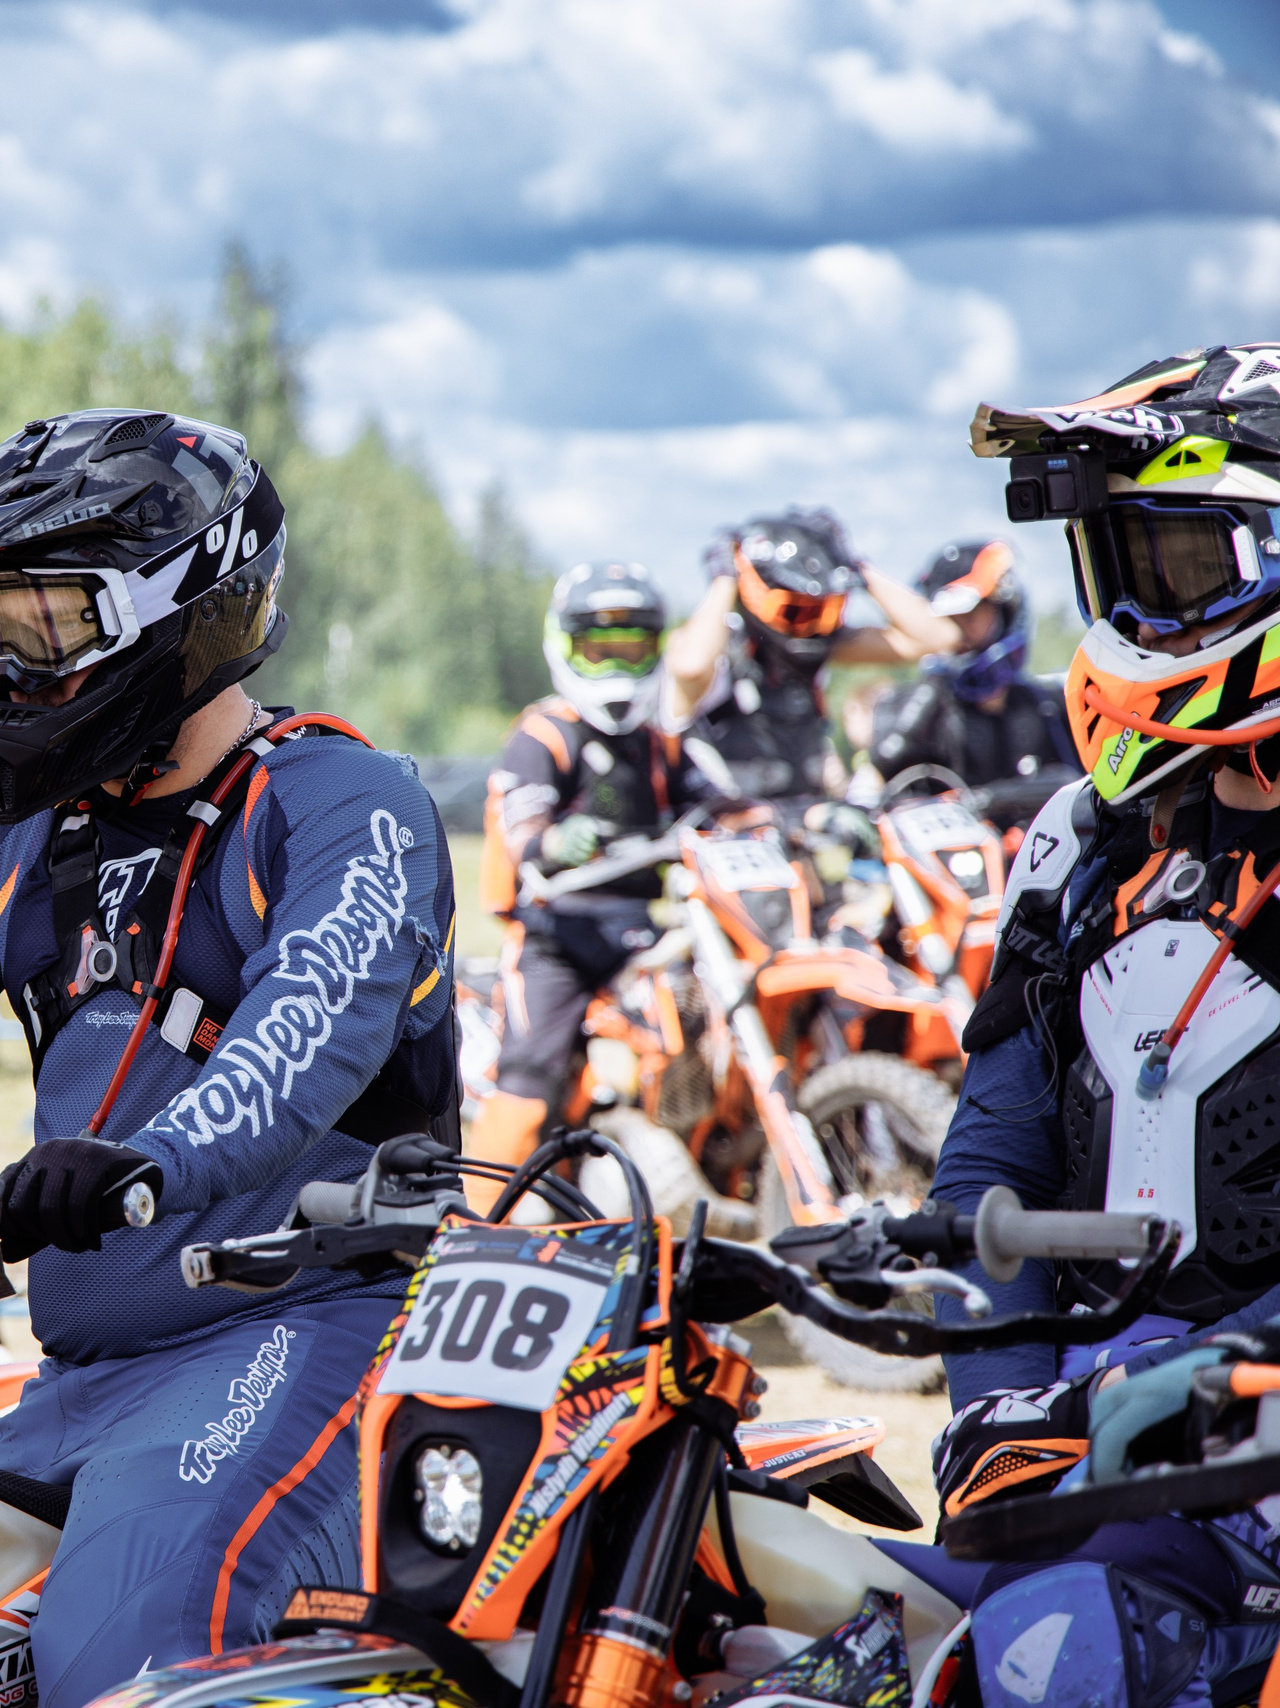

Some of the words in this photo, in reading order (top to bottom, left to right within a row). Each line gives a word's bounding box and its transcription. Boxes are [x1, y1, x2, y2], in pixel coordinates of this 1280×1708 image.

[1108, 711, 1140, 775] Airo
[203, 1022, 218, 1034] NO
[399, 1278, 571, 1372] 308
